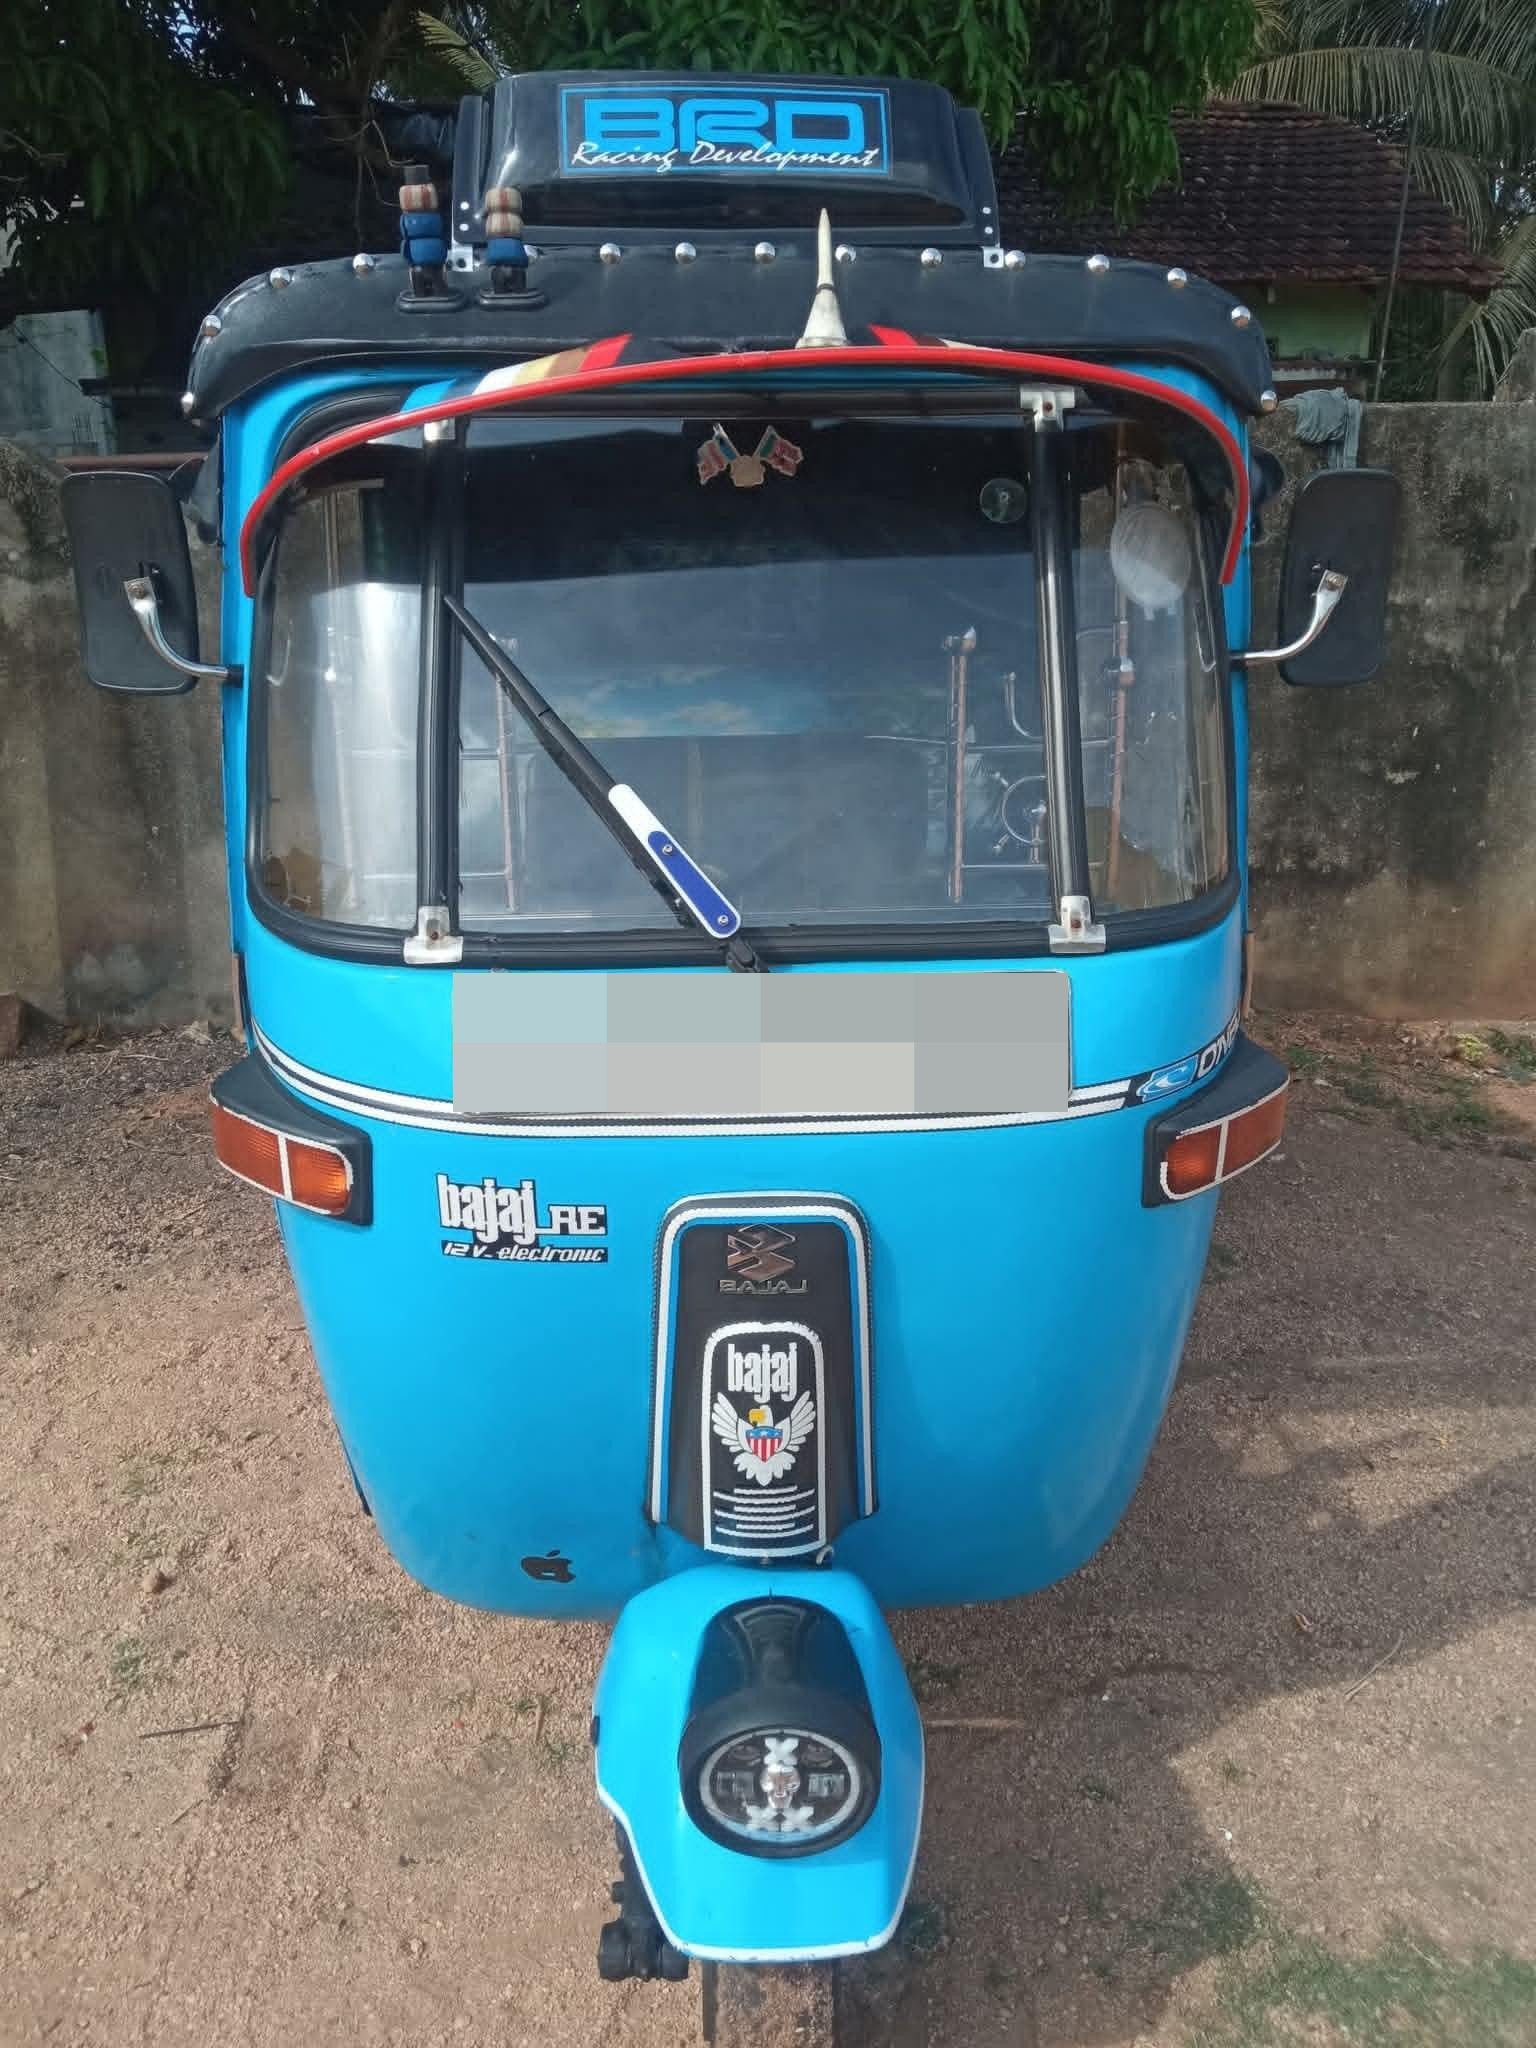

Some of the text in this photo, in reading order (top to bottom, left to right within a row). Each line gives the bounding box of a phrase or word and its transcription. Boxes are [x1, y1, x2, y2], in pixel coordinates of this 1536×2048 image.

[584, 98, 865, 153] BRD
[571, 140, 879, 171] Racing Development
[436, 1173, 536, 1245] bajaj
[497, 1244, 604, 1262] electronic
[719, 1279, 808, 1294] BAJAJ
[728, 1342, 797, 1402] bajaj
